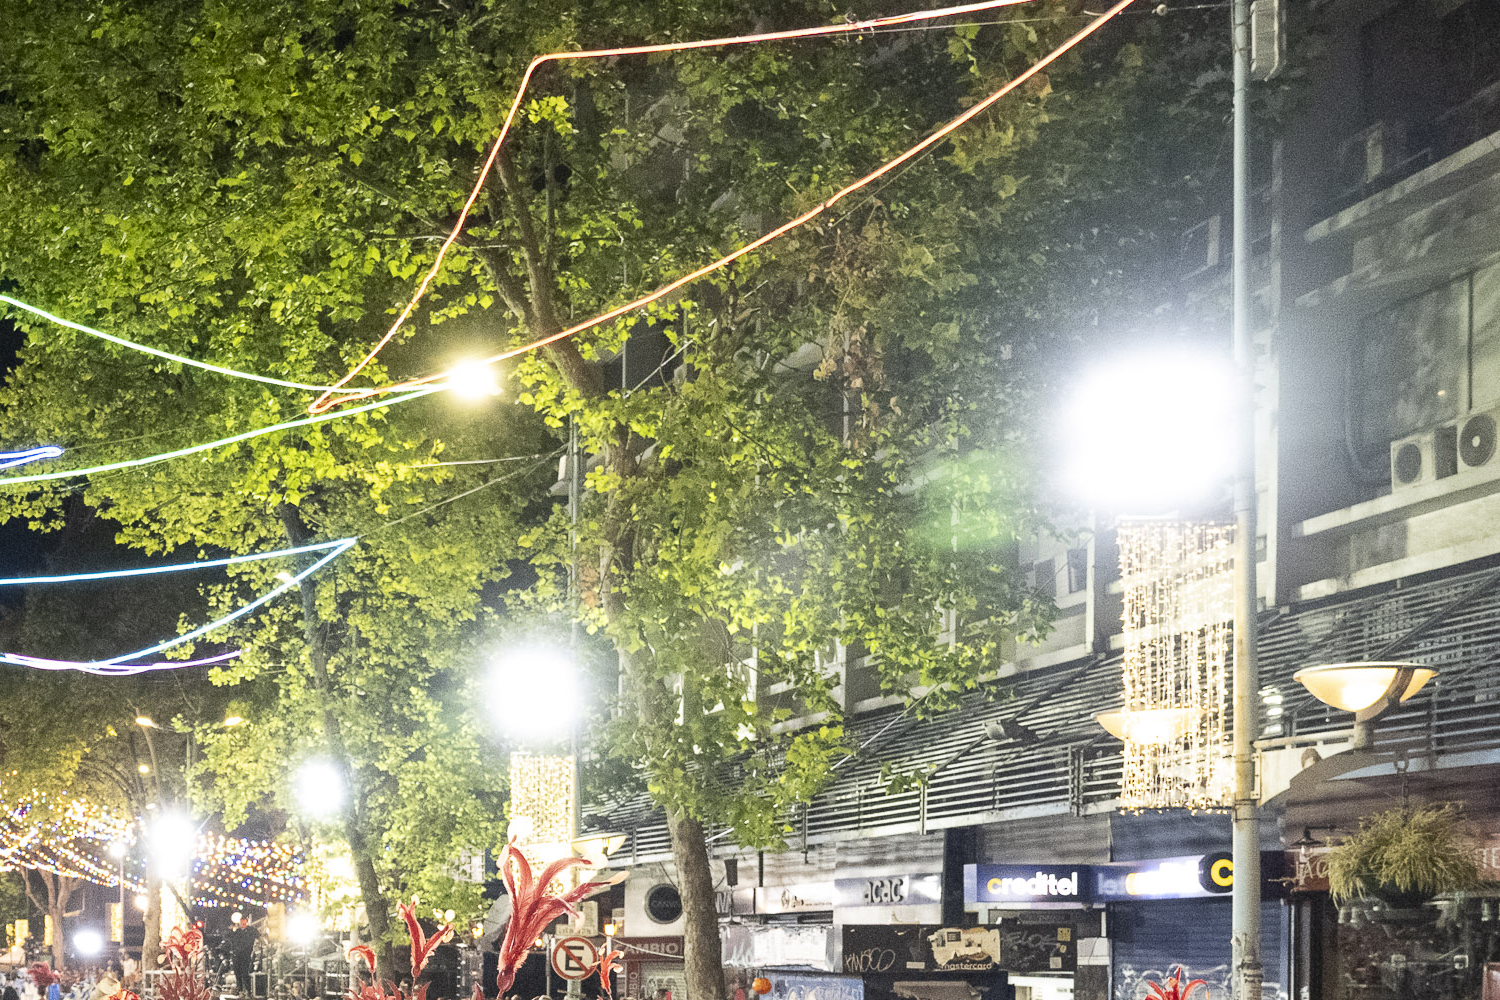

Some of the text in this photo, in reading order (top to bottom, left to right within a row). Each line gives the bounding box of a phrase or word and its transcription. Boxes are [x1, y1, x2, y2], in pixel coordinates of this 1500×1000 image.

[987, 871, 1078, 896] creditel
[565, 946, 585, 971] E
[613, 942, 679, 955] CAMBIO
